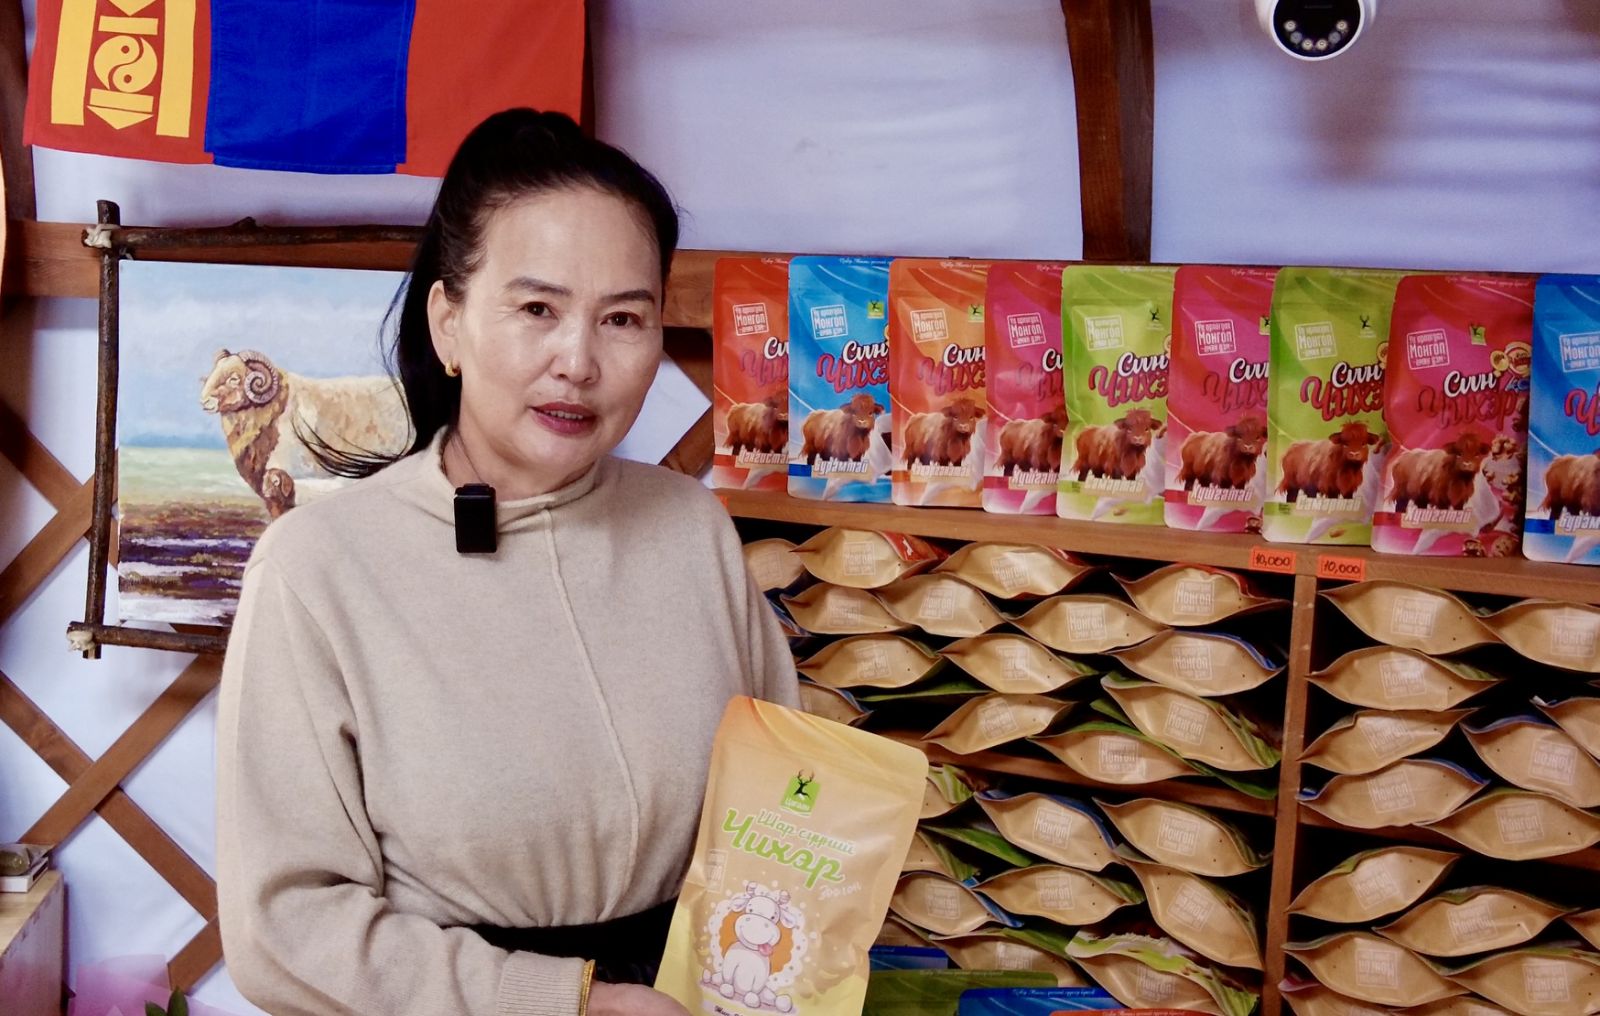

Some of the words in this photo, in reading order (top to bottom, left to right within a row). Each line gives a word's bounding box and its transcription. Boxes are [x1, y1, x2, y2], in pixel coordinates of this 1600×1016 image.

[737, 314, 765, 326] Монгол
[815, 316, 844, 329] Монгол
[1011, 324, 1041, 337] Монгол
[1199, 331, 1232, 345] Монгол
[1409, 343, 1445, 359] Монгол
[1256, 553, 1290, 567] 10,000
[1323, 560, 1361, 575] 10,000
[756, 809, 796, 839] Шар
[720, 808, 845, 889] Чихэр
